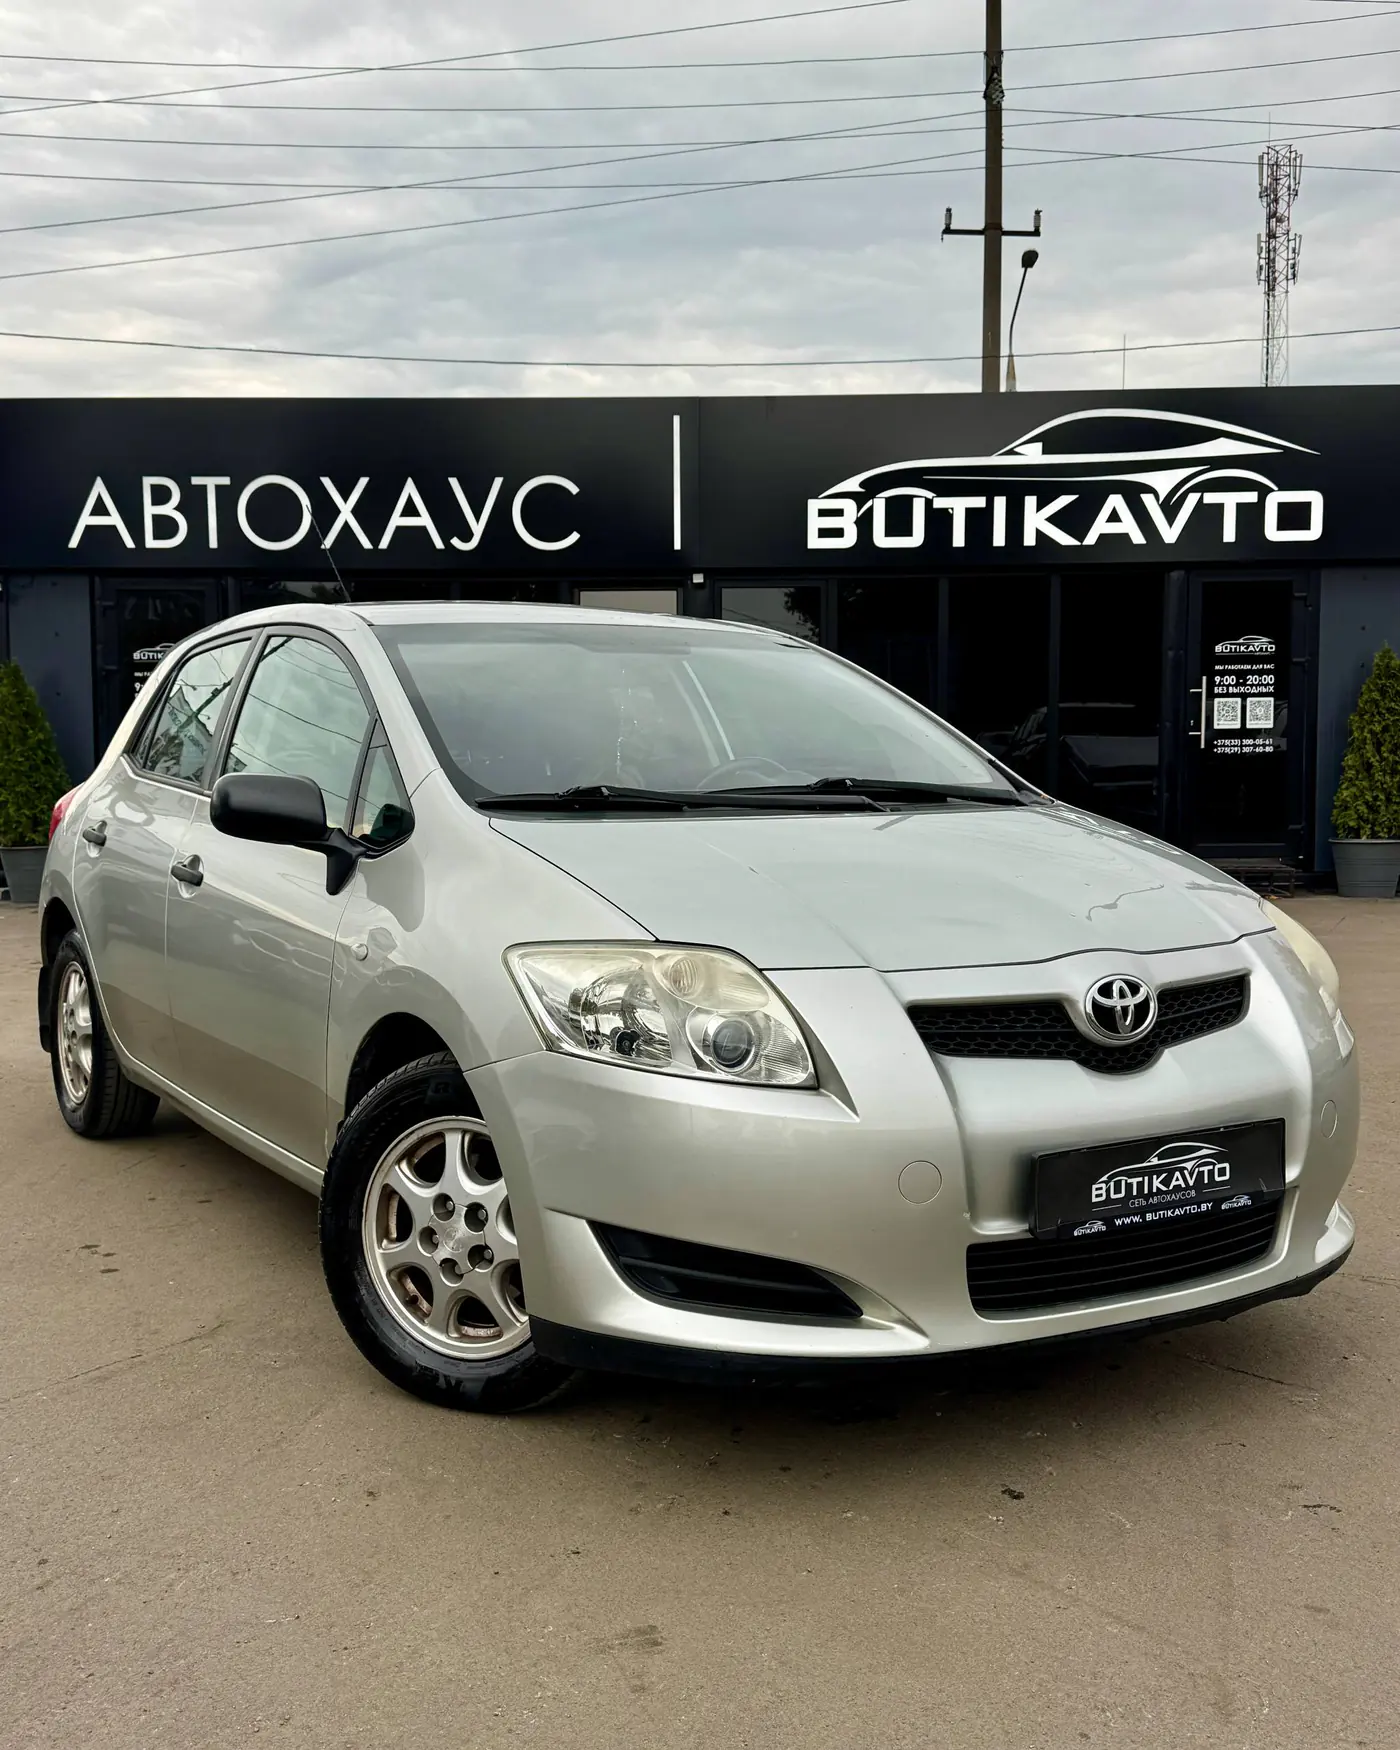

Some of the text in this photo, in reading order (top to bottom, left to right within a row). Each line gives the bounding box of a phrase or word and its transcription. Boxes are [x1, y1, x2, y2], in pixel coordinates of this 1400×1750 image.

[67, 474, 582, 552] АВТОХАУС
[806, 489, 1325, 550] BUTIKAVTO
[133, 651, 164, 660] BUTIK
[1214, 644, 1276, 652] BUTIKAVTO
[1214, 675, 1236, 685] 9:00
[1246, 674, 1275, 685] 20:00
[1214, 685, 1275, 694] БЕЗ ВЫХОДНЫХ
[1092, 1162, 1230, 1203] BUTIKAVTO
[1128, 1189, 1197, 1208] СЕТЬ АВТОХАУСОВ
[1145, 1202, 1214, 1221] BUTIKAVTO.BY
